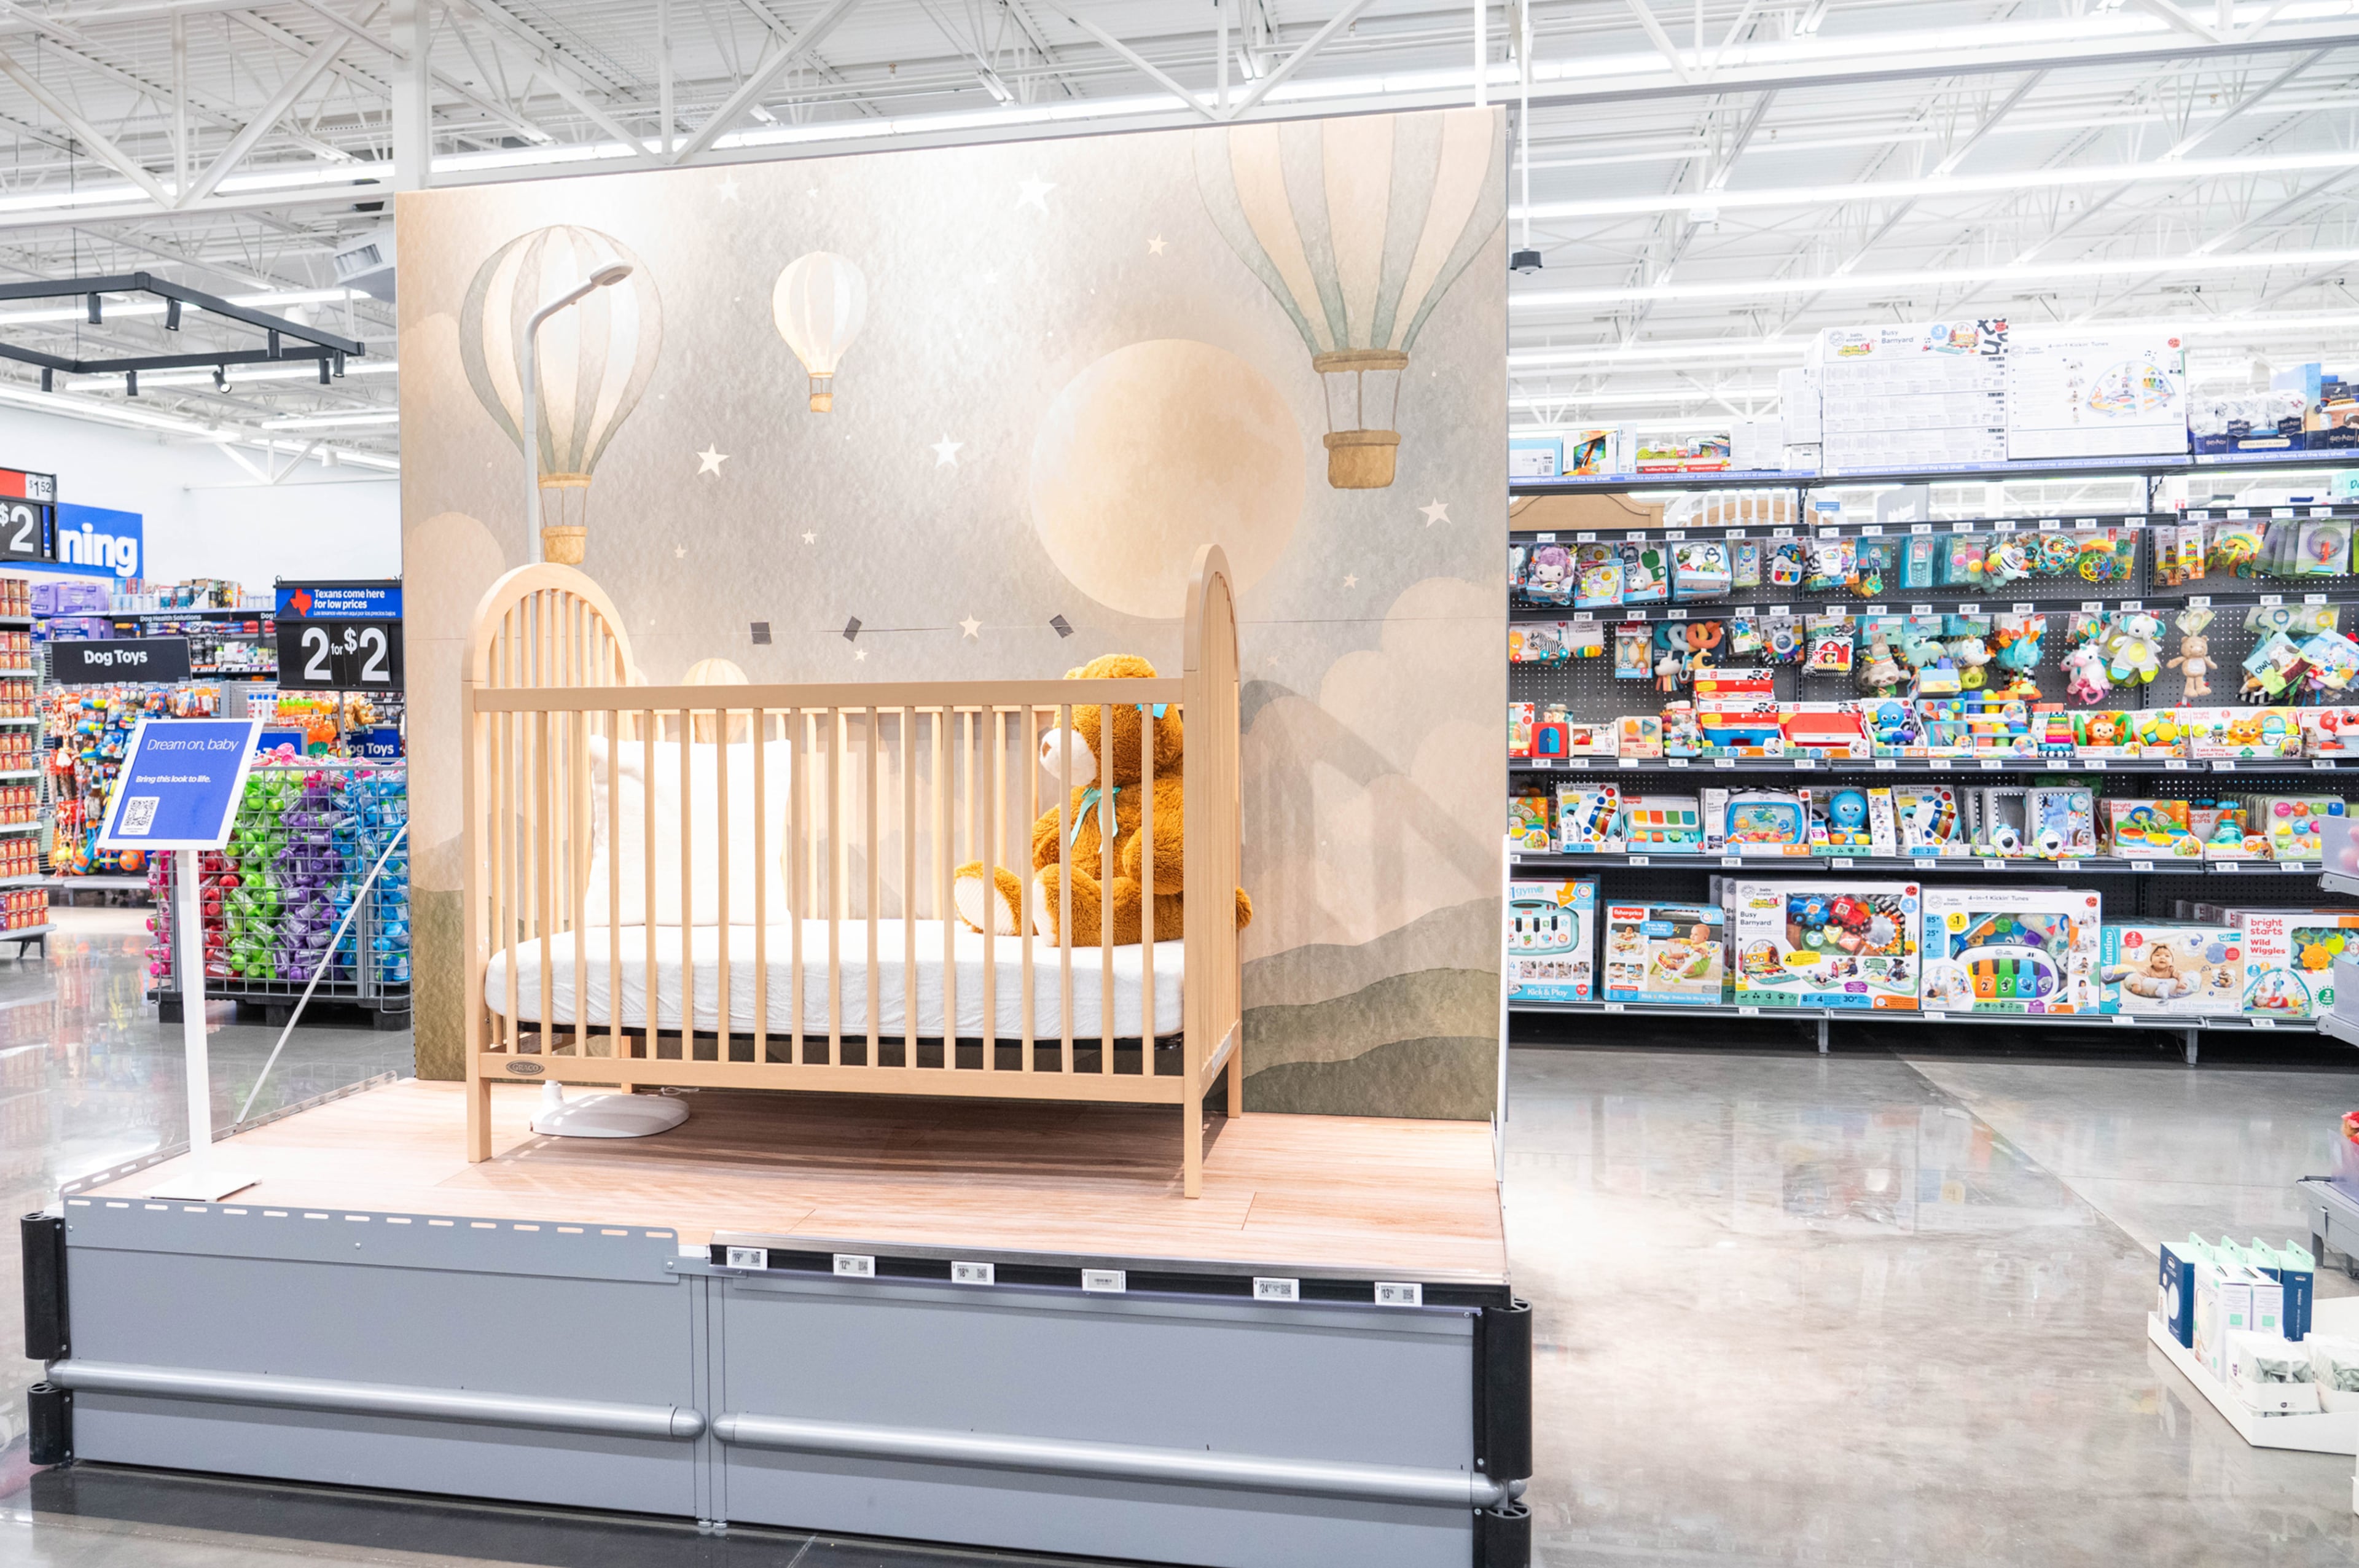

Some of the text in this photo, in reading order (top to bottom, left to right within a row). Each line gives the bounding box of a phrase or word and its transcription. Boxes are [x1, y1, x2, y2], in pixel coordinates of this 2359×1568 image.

[314, 589, 342, 599] Texans
[366, 589, 385, 599] here
[314, 599, 367, 610] for low prices
[84, 650, 147, 666] Dog Toys
[302, 627, 332, 680] 2
[331, 643, 343, 655] for
[2255, 659, 2272, 674] OWL
[147, 738, 239, 752] Dream on, baby
[366, 743, 394, 756] Toys
[135, 775, 155, 784] Bring
[2251, 919, 2283, 928] bright
[2250, 946, 2285, 955] Wiggles
[2001, 982, 2008, 991] 3
[512, 1063, 539, 1072] GRACO
